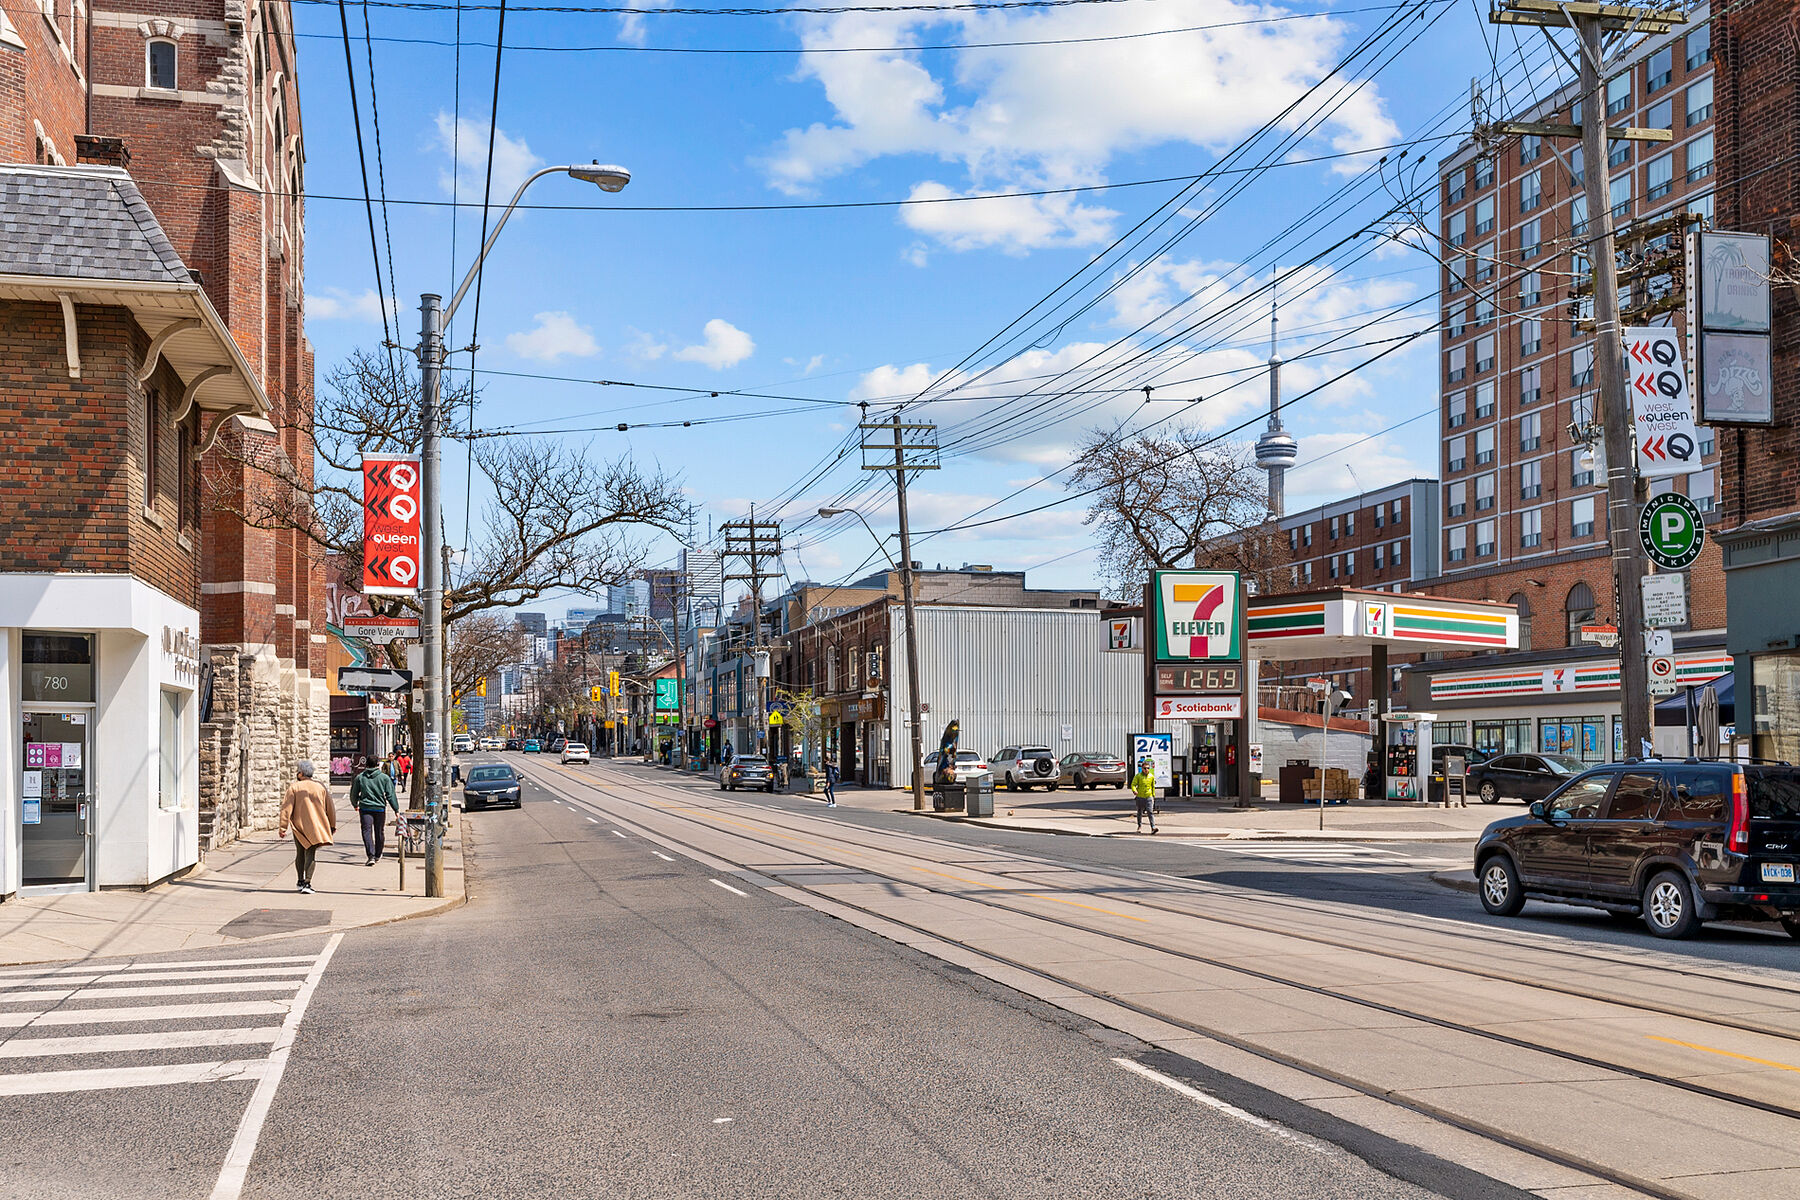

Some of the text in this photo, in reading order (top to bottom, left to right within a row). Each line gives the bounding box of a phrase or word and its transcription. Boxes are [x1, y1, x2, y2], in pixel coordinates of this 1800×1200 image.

[1727, 284, 1759, 297] DRINKS
[1644, 403, 1674, 412] west
[1647, 421, 1678, 431] west
[1642, 495, 1701, 529] MUNICIPAL
[374, 525, 404, 534] west
[1661, 512, 1685, 542] P
[374, 544, 404, 553] west
[1643, 537, 1702, 566] PARKING
[1173, 584, 1224, 658] 7
[358, 626, 405, 636] Gore Vale Av
[1594, 633, 1613, 641] Walnut
[44, 676, 68, 690] 780
[1182, 669, 1237, 689] 126.9
[1176, 702, 1233, 713] Scotiabank
